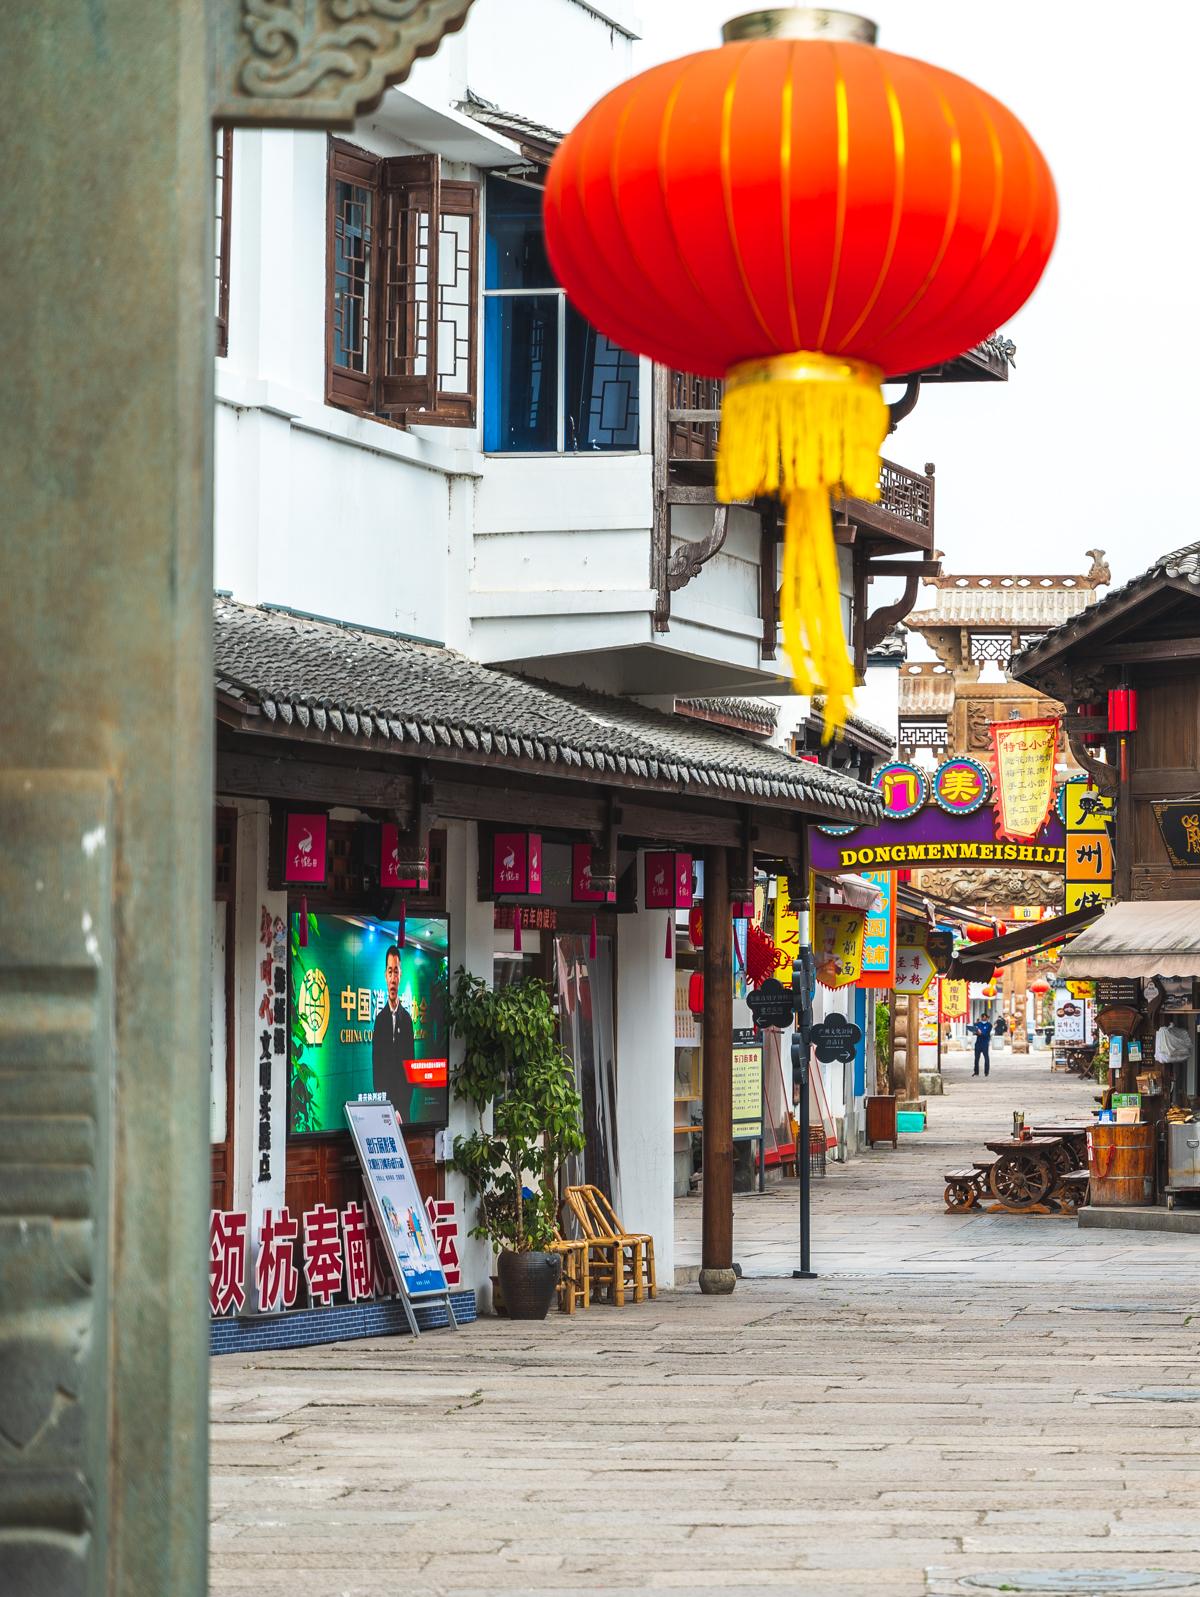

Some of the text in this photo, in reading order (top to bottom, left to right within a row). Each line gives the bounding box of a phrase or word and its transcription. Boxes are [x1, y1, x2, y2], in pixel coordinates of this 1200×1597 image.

[1003, 739, 1054, 753] 特色小吃
[841, 842, 1065, 866] DONGMENMEISHIJI
[340, 1028, 363, 1044] CHINA
